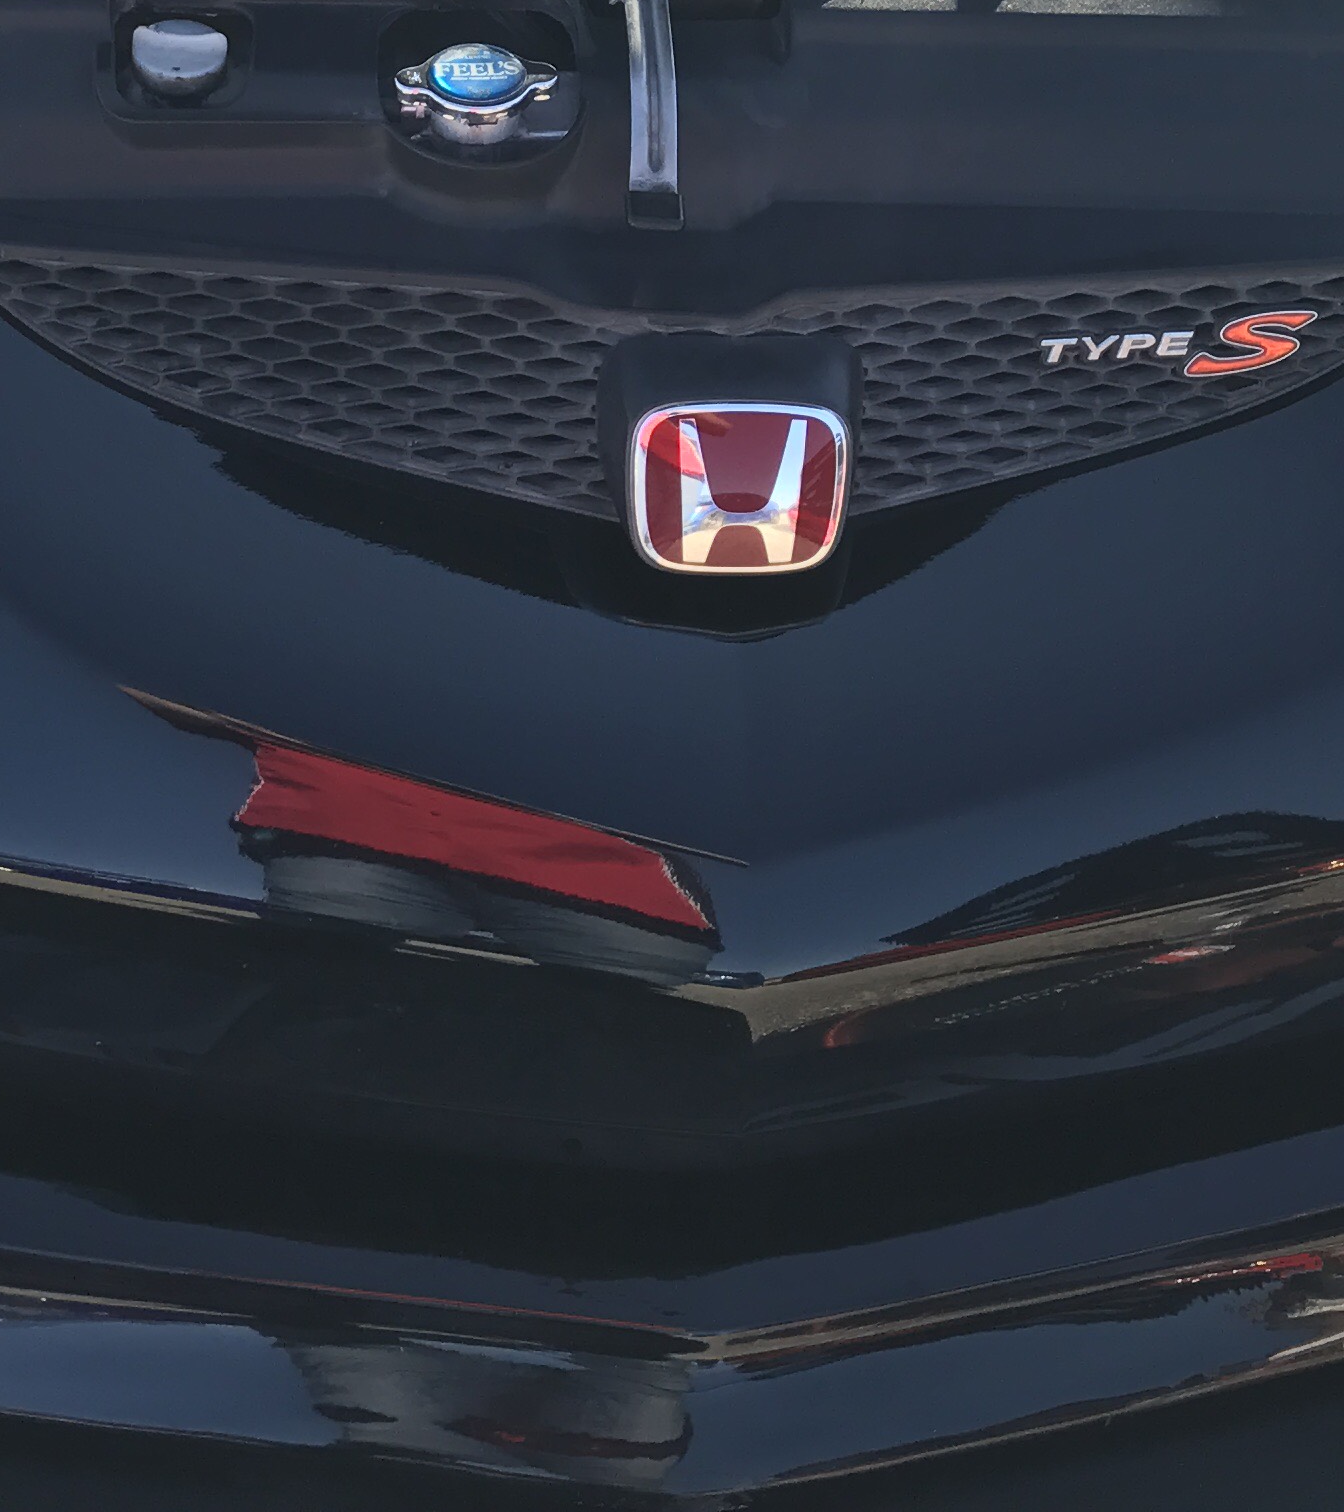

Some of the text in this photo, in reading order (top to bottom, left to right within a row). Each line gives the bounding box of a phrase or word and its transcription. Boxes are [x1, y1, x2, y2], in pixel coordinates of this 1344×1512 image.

[434, 60, 520, 77] FEEL'S
[1039, 309, 1318, 378] TYPE S
